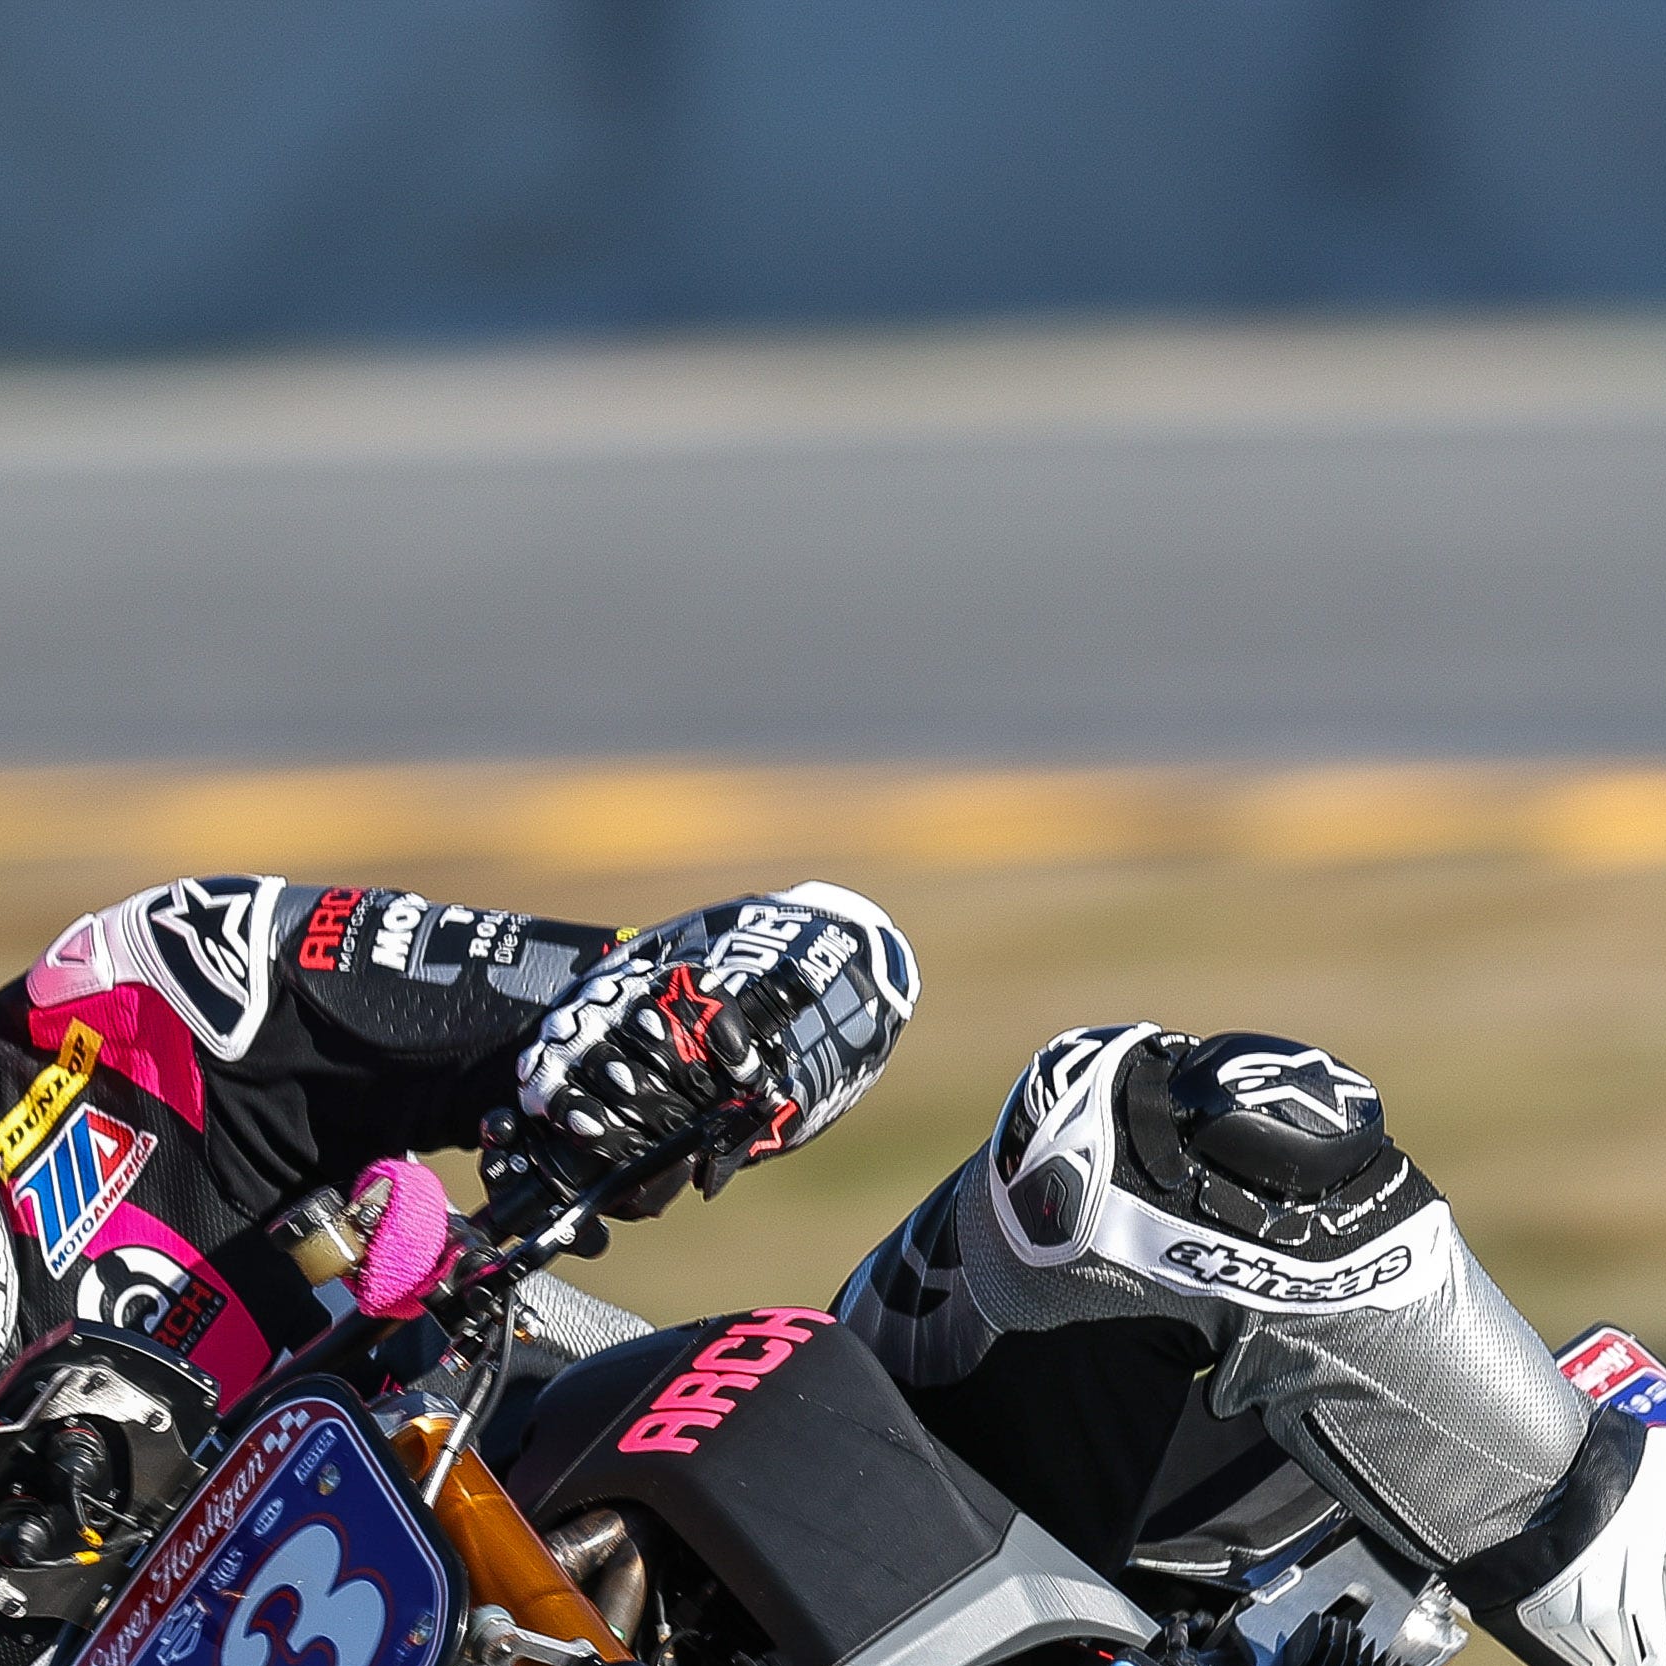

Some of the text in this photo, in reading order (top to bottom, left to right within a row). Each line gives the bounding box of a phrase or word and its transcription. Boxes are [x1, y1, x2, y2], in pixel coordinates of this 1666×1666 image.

[298, 887, 363, 971] ARC
[50, 1136, 154, 1272] MOTOAMERICA
[153, 1281, 213, 1348] RCH
[1165, 1239, 1413, 1304] alpinestars
[617, 1307, 838, 1455] ARCH
[149, 1448, 266, 1604] Hooligan
